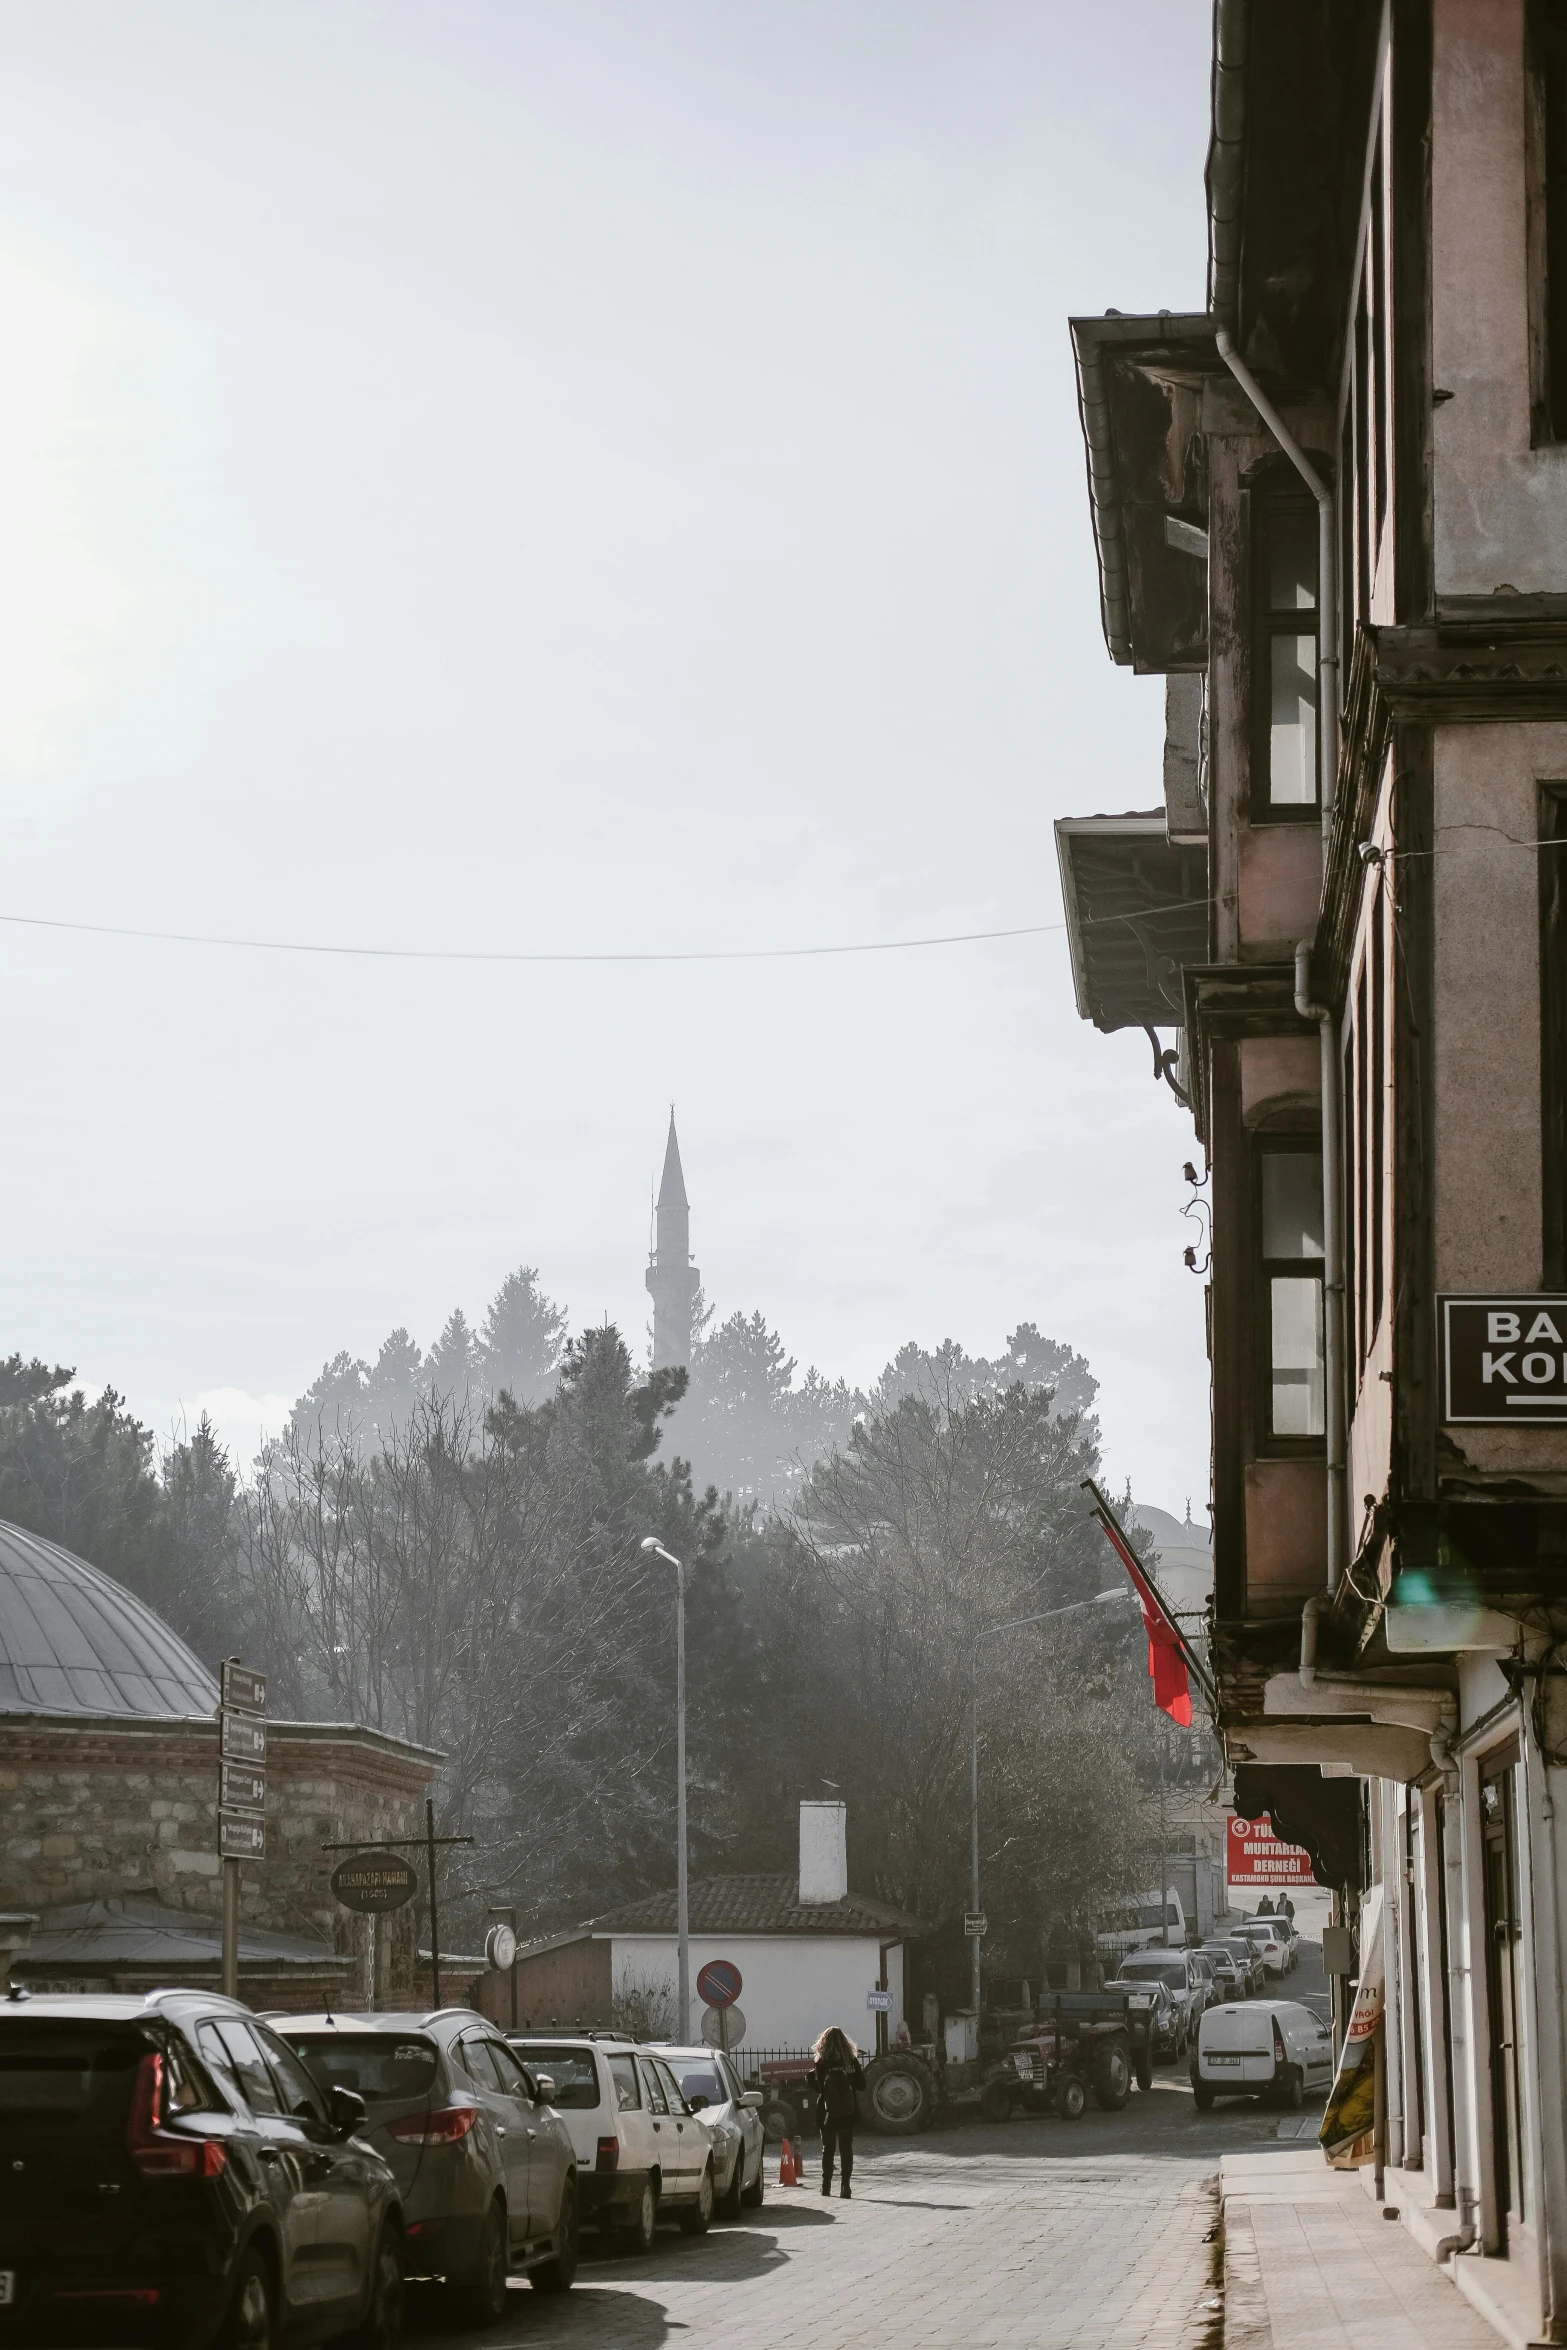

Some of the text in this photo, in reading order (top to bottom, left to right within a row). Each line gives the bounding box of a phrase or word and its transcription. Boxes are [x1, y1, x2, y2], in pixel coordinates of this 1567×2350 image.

[1487, 1312, 1564, 1344] BA
[1482, 1352, 1567, 1384] KO
[1253, 1858, 1301, 1873] DERNEĞİ
[1231, 1874, 1269, 1883] KASTAMONU
[1270, 1874, 1287, 1884] ŞUBE
[1357, 2024, 1369, 2034] 85
